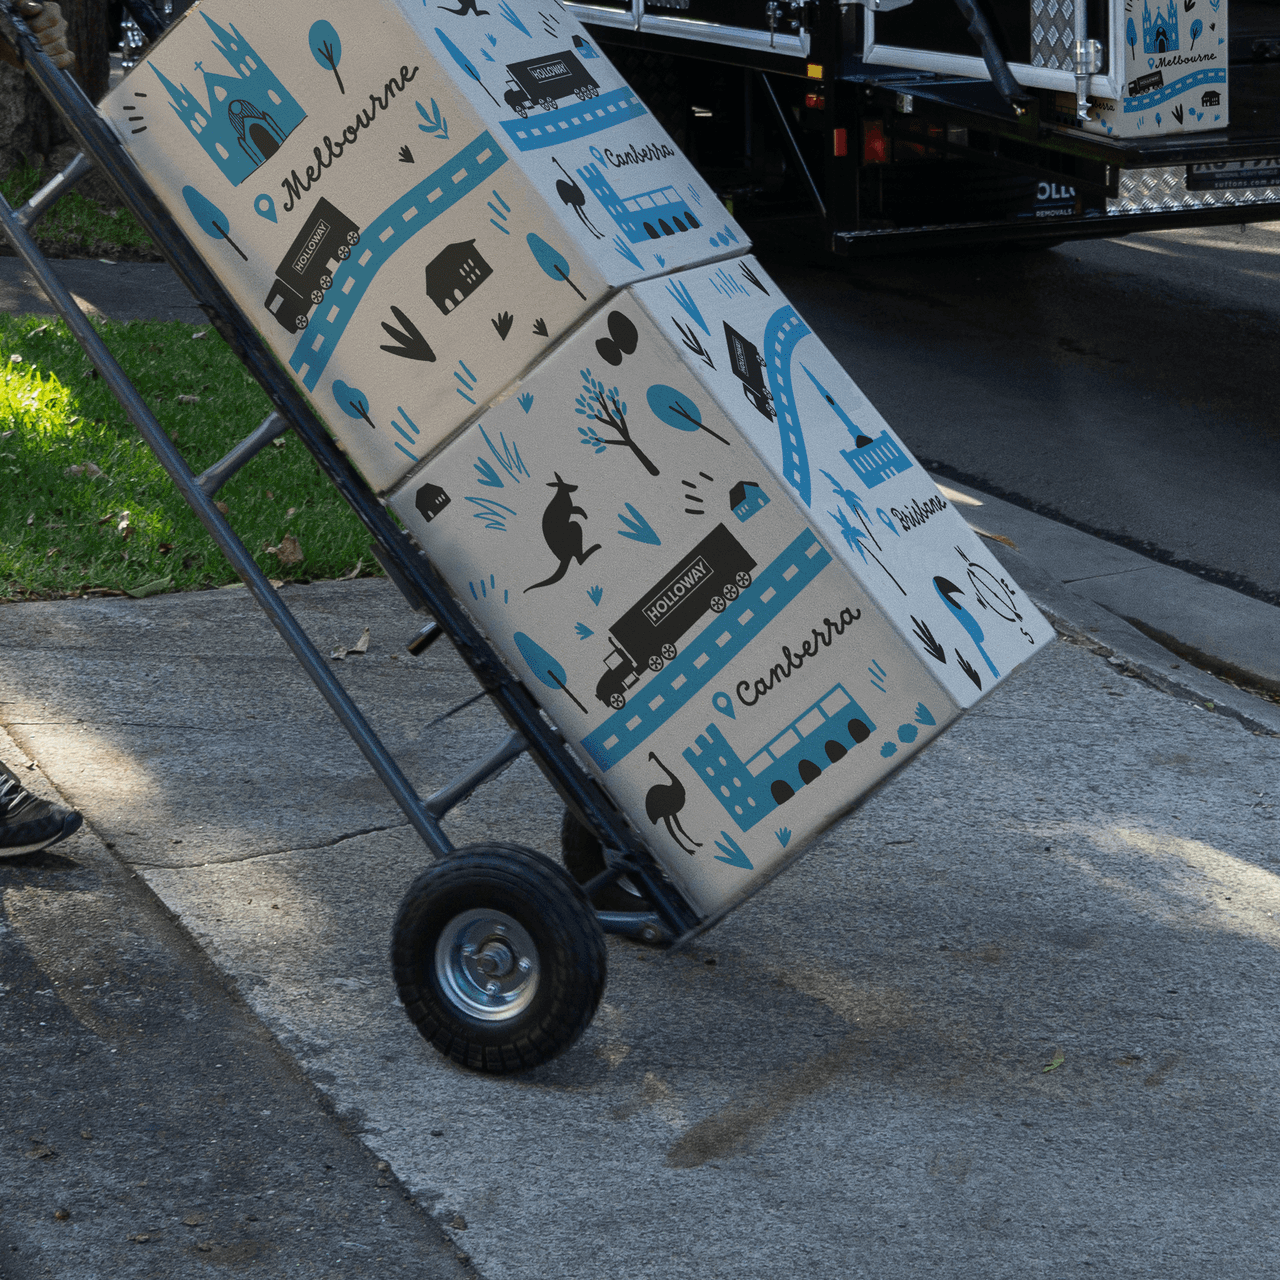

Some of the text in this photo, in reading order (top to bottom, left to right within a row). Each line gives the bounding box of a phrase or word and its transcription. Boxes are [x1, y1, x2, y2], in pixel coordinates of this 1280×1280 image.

[532, 62, 568, 81] HOLLOWAY
[1155, 52, 1218, 70] Melbourne
[281, 65, 420, 213] Melbourne
[604, 143, 675, 168] Canberra
[1214, 179, 1280, 189] suttons.com.au
[1035, 208, 1073, 218] REMOVALS
[295, 222, 328, 272] HOLLOWAY
[890, 494, 948, 532] Brisbane
[646, 561, 708, 622] HOLLOWAY
[736, 606, 862, 707] Canberra
